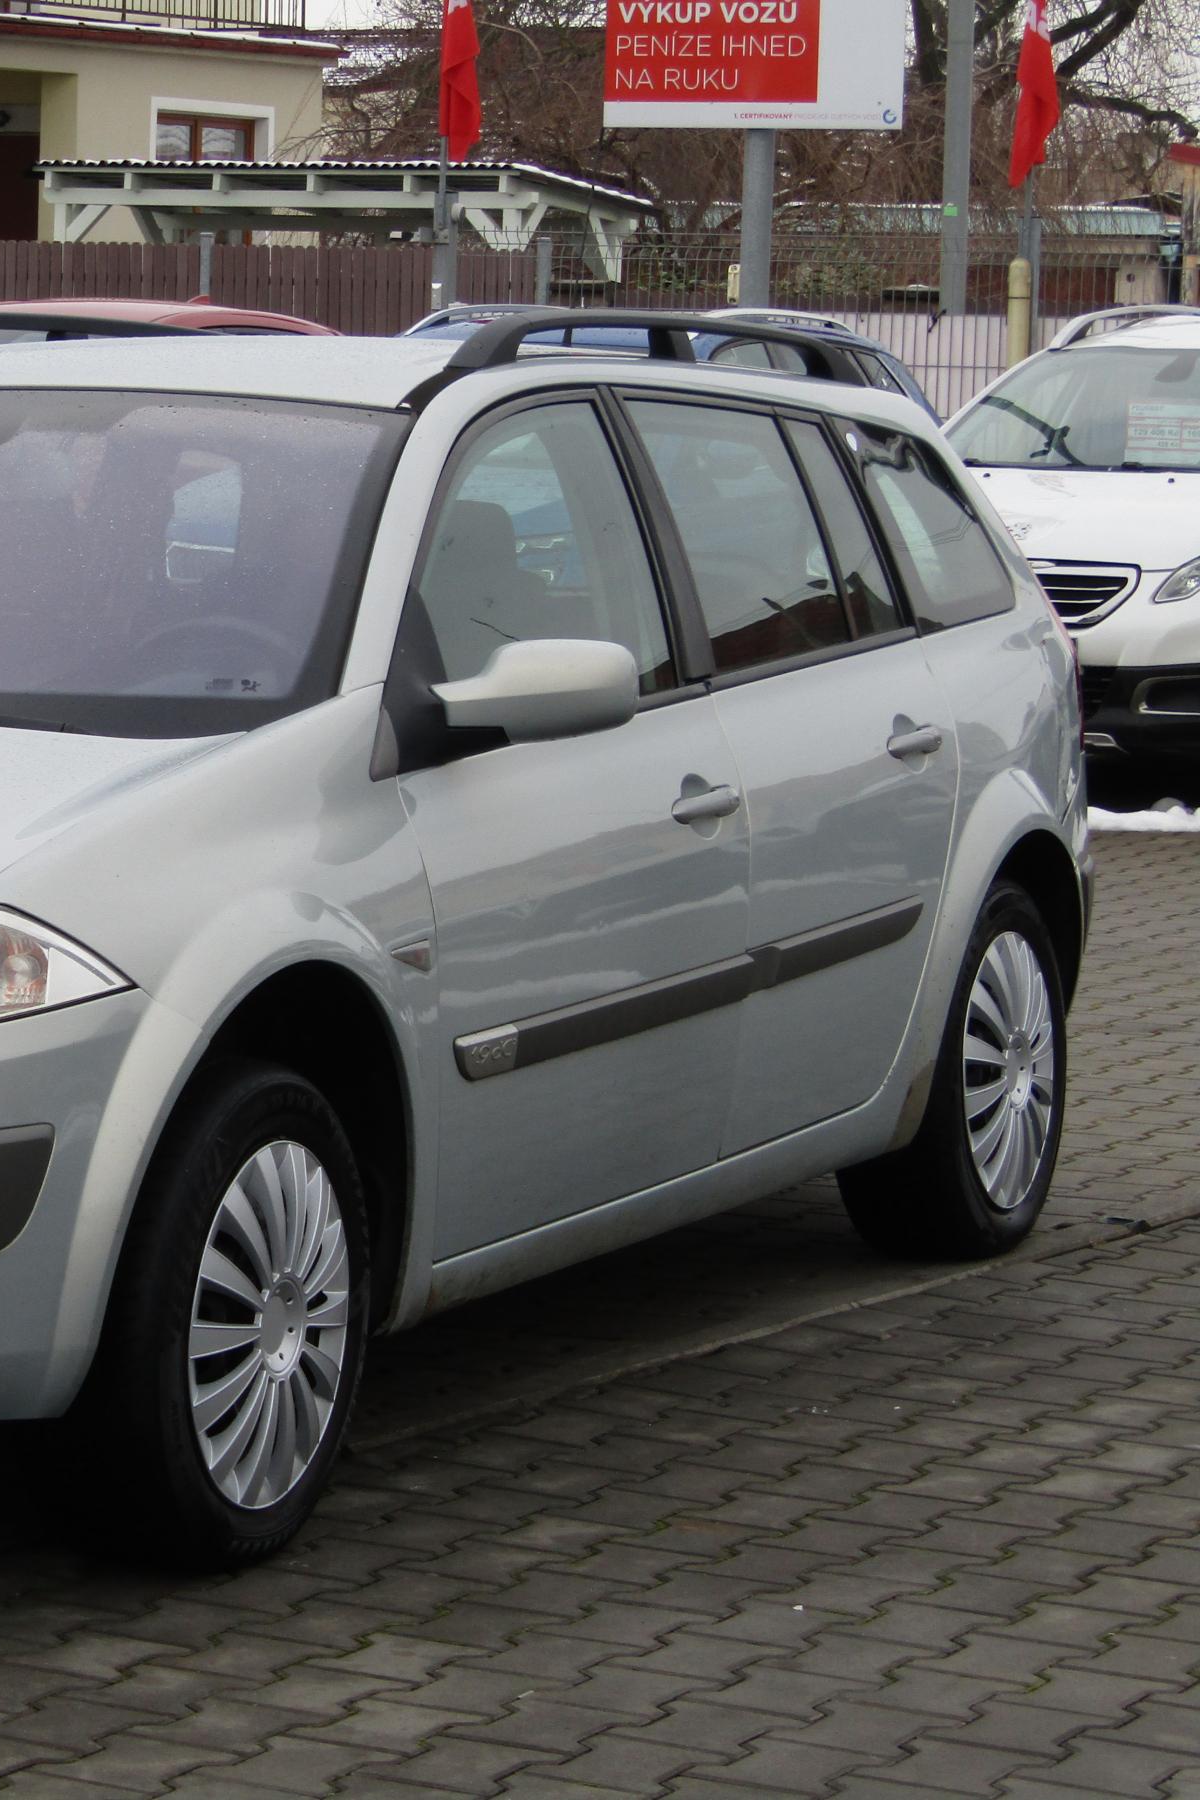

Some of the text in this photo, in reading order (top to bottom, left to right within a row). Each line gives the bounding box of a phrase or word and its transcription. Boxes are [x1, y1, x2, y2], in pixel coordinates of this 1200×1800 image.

[618, 0, 798, 24] VÝKUP VOZŮ
[615, 30, 806, 57] PENÍZE IHNED
[615, 68, 739, 90] NA RUKU
